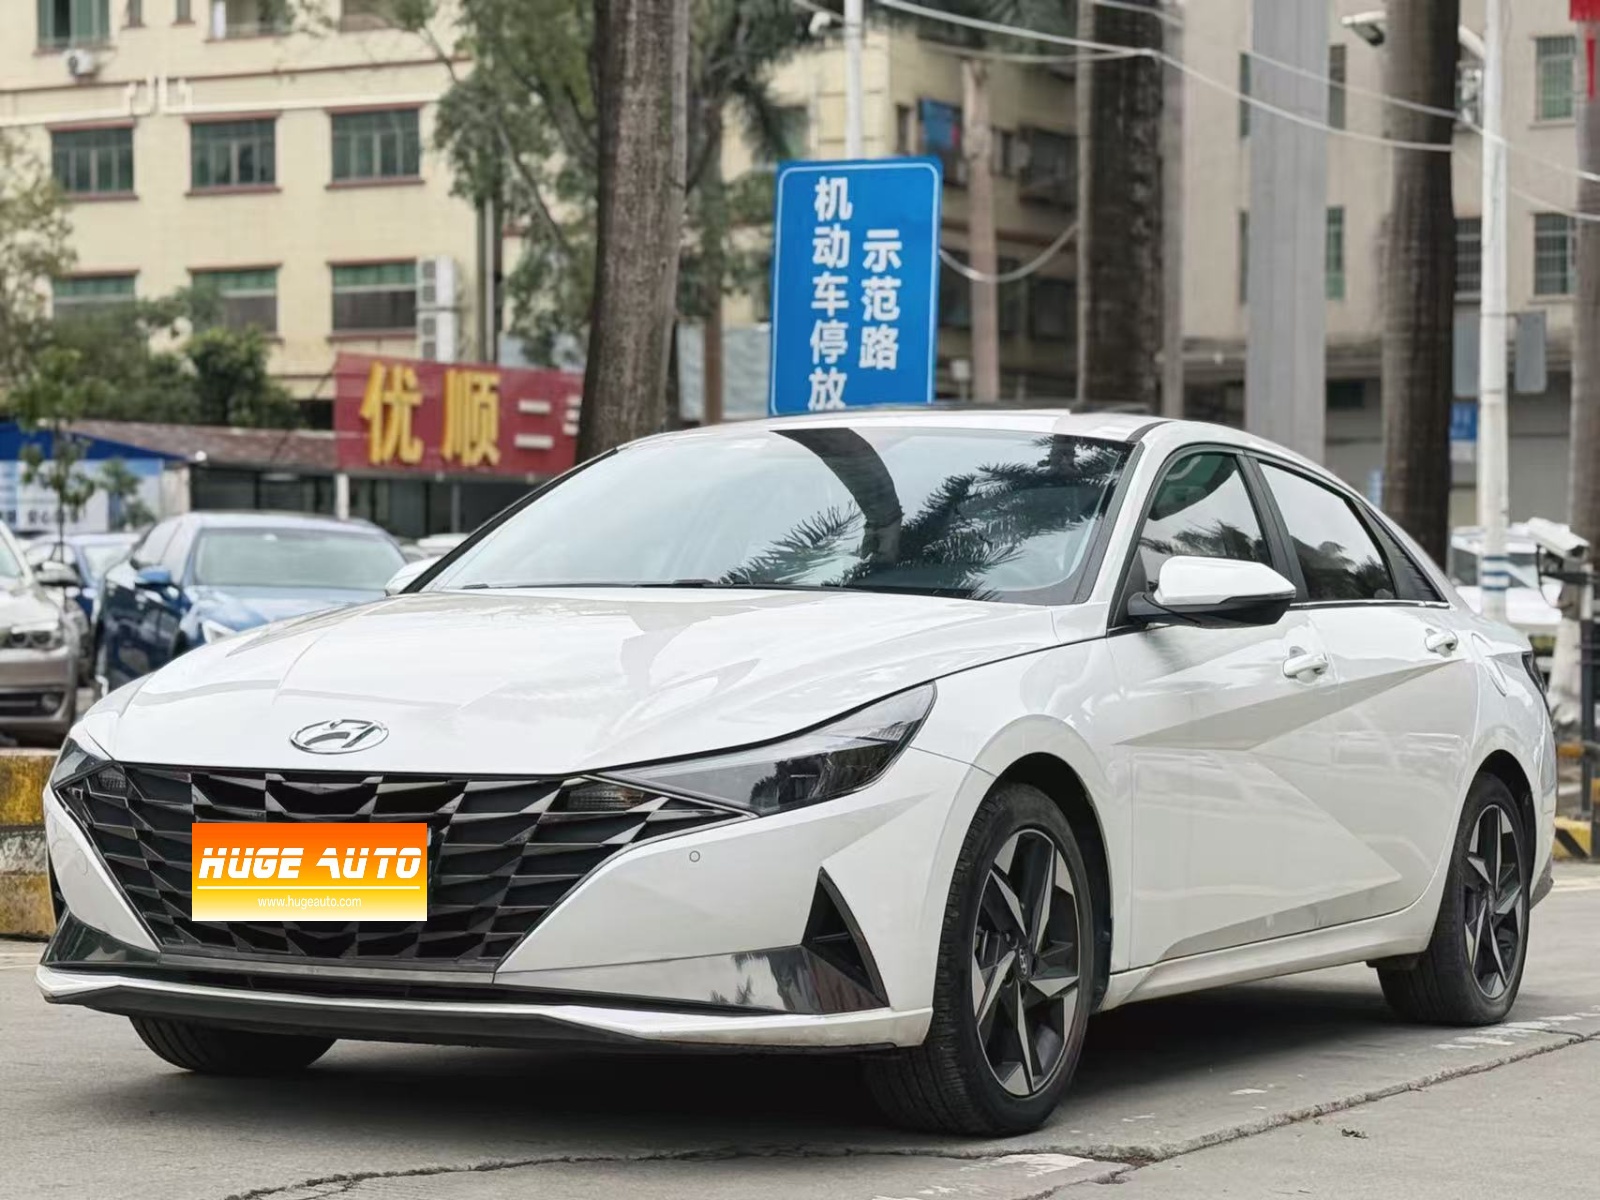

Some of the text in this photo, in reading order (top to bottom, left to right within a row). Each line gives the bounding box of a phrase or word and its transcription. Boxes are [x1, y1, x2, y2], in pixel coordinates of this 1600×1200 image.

[808, 176, 853, 411] 机动车停放
[858, 229, 902, 370] 示范路
